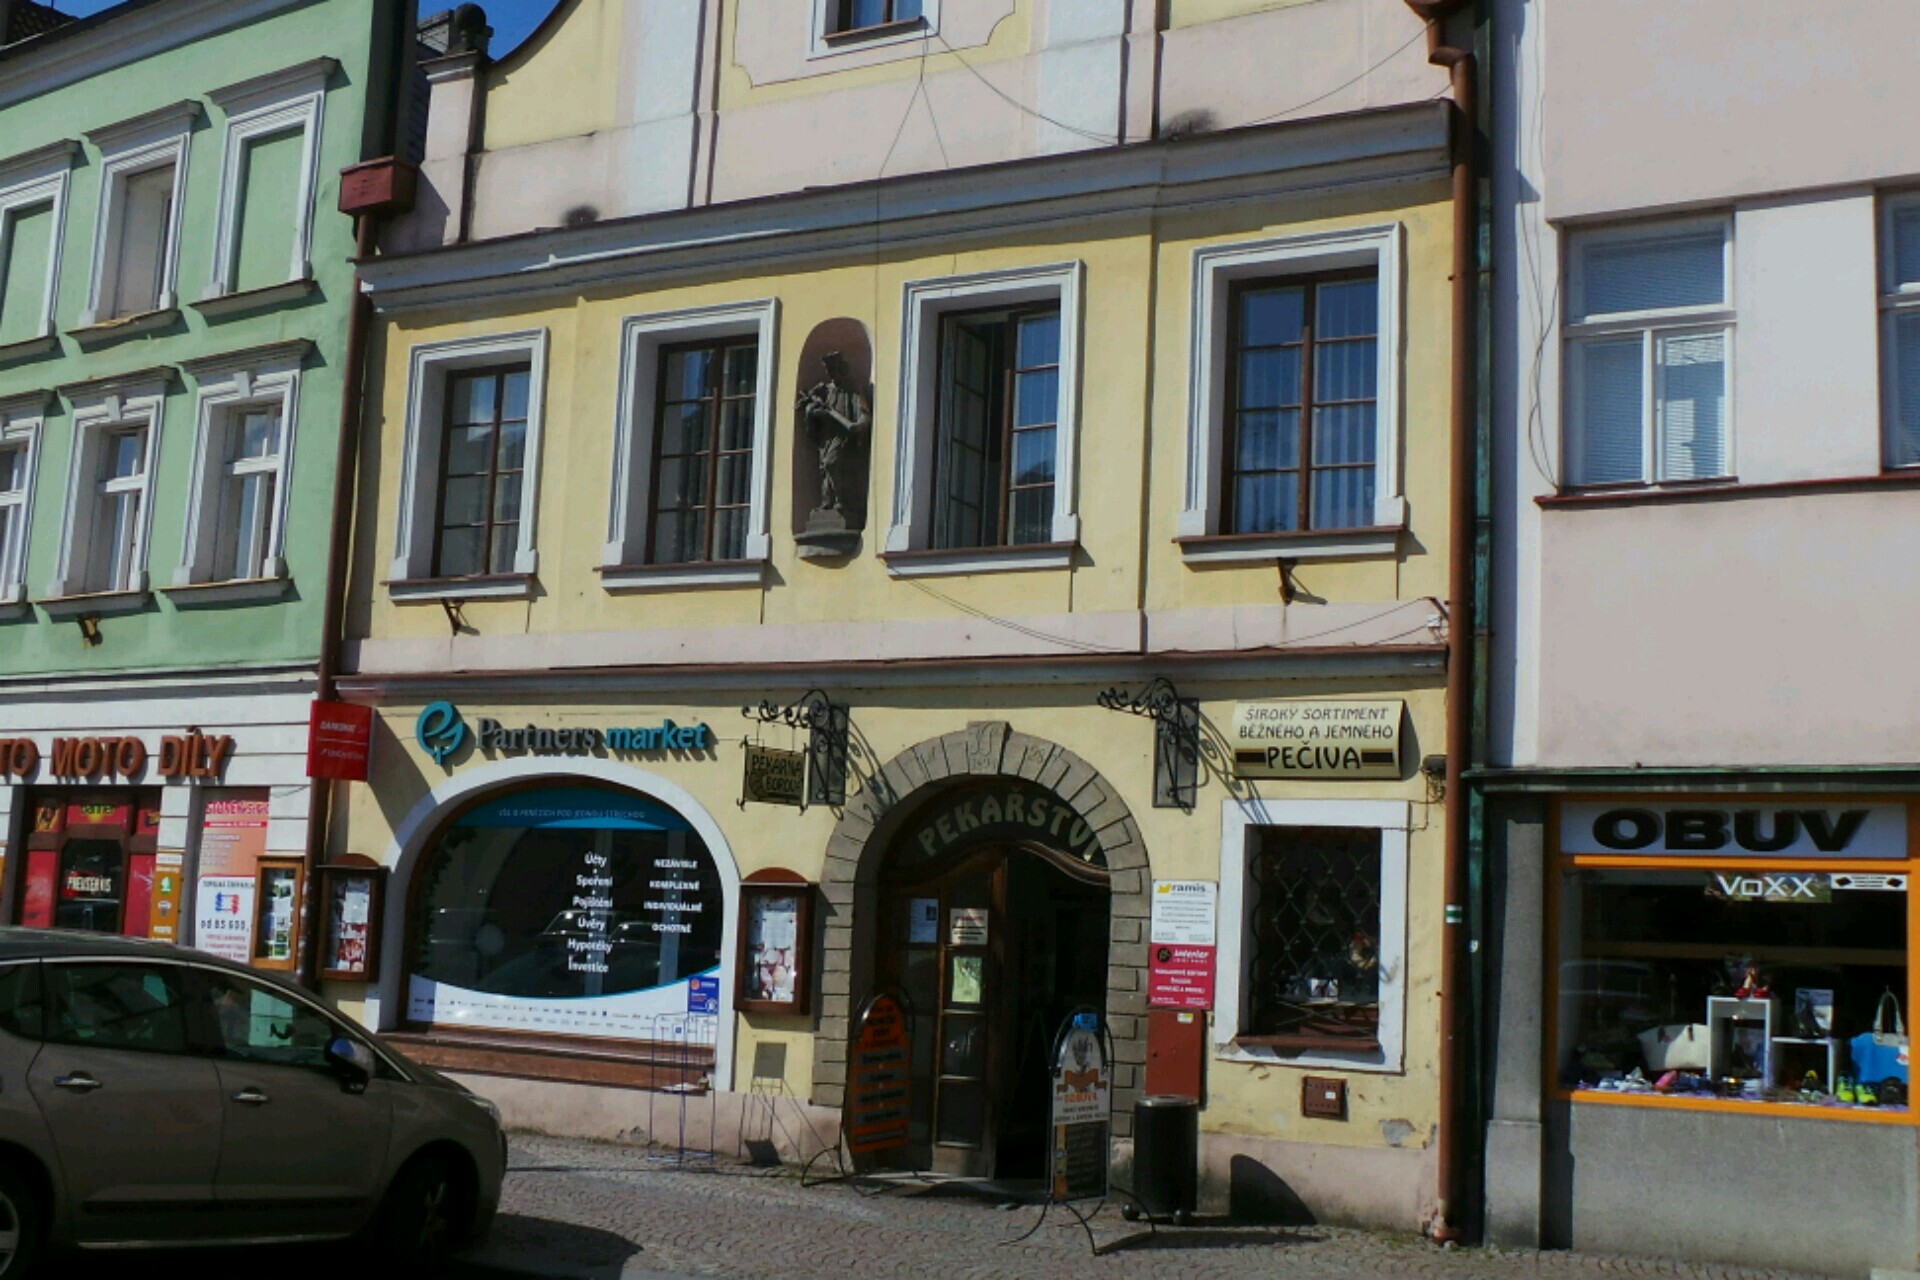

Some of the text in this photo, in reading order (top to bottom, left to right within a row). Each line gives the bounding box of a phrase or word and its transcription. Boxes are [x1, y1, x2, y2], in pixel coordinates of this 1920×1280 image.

[1302, 708, 1390, 721] SORTIMENT
[475, 717, 708, 751] Partners market
[1309, 726, 1320, 739] A
[50, 735, 147, 777] MOTO
[156, 725, 232, 777] DÍLY
[1266, 741, 1361, 769] PEČIVA
[1593, 807, 1869, 852] OBUV
[584, 851, 607, 868] Účty
[576, 875, 613, 888] Spoření
[572, 895, 613, 909] Pojištění
[577, 917, 606, 931] Úvěry
[567, 938, 613, 954] Hypotéky
